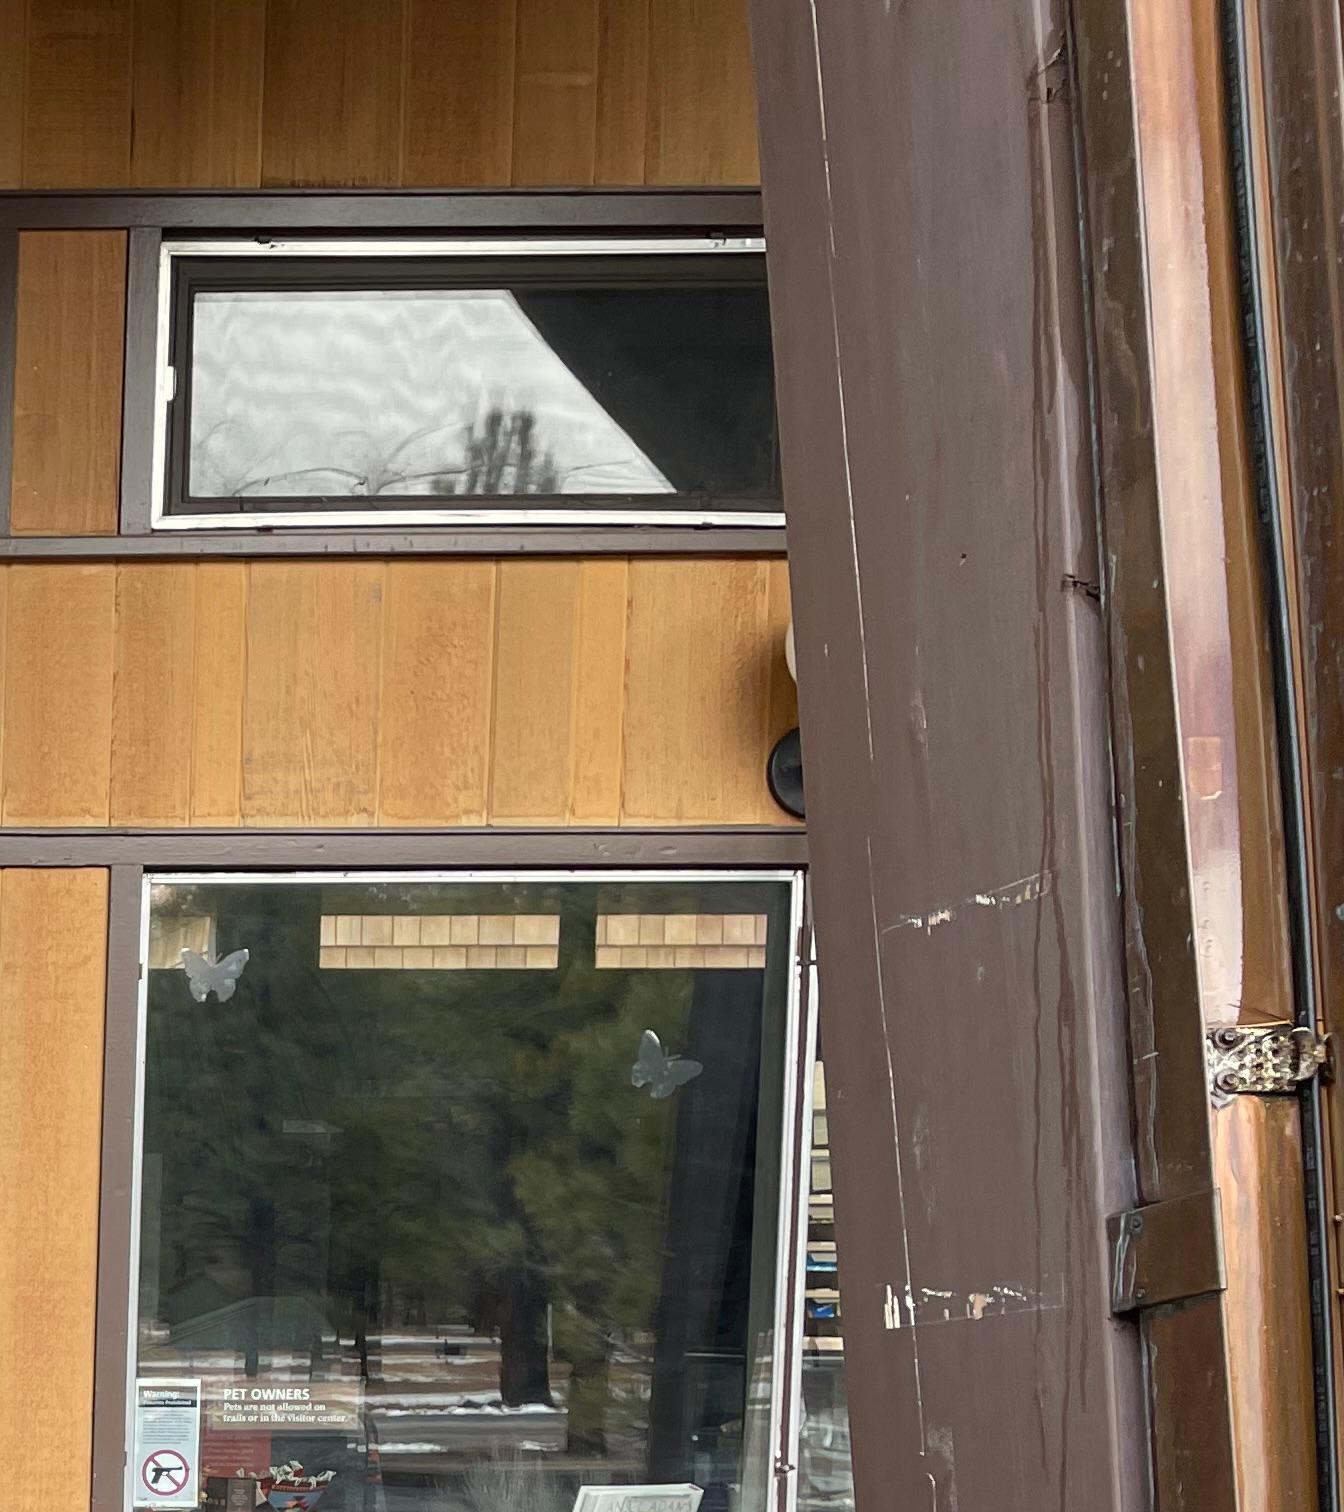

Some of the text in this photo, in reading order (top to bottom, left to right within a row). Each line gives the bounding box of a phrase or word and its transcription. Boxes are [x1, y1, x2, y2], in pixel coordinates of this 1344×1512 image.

[143, 1390, 180, 1400] Warning:
[223, 1388, 310, 1401] PET OWNERS
[223, 1402, 242, 1411] Pets
[260, 1403, 276, 1411] not
[277, 1402, 312, 1411] allowed
[223, 1414, 246, 1422] trails
[260, 1414, 270, 1422] in
[271, 1414, 285, 1422] the
[287, 1414, 316, 1422] visitor
[317, 1415, 348, 1423] center.
